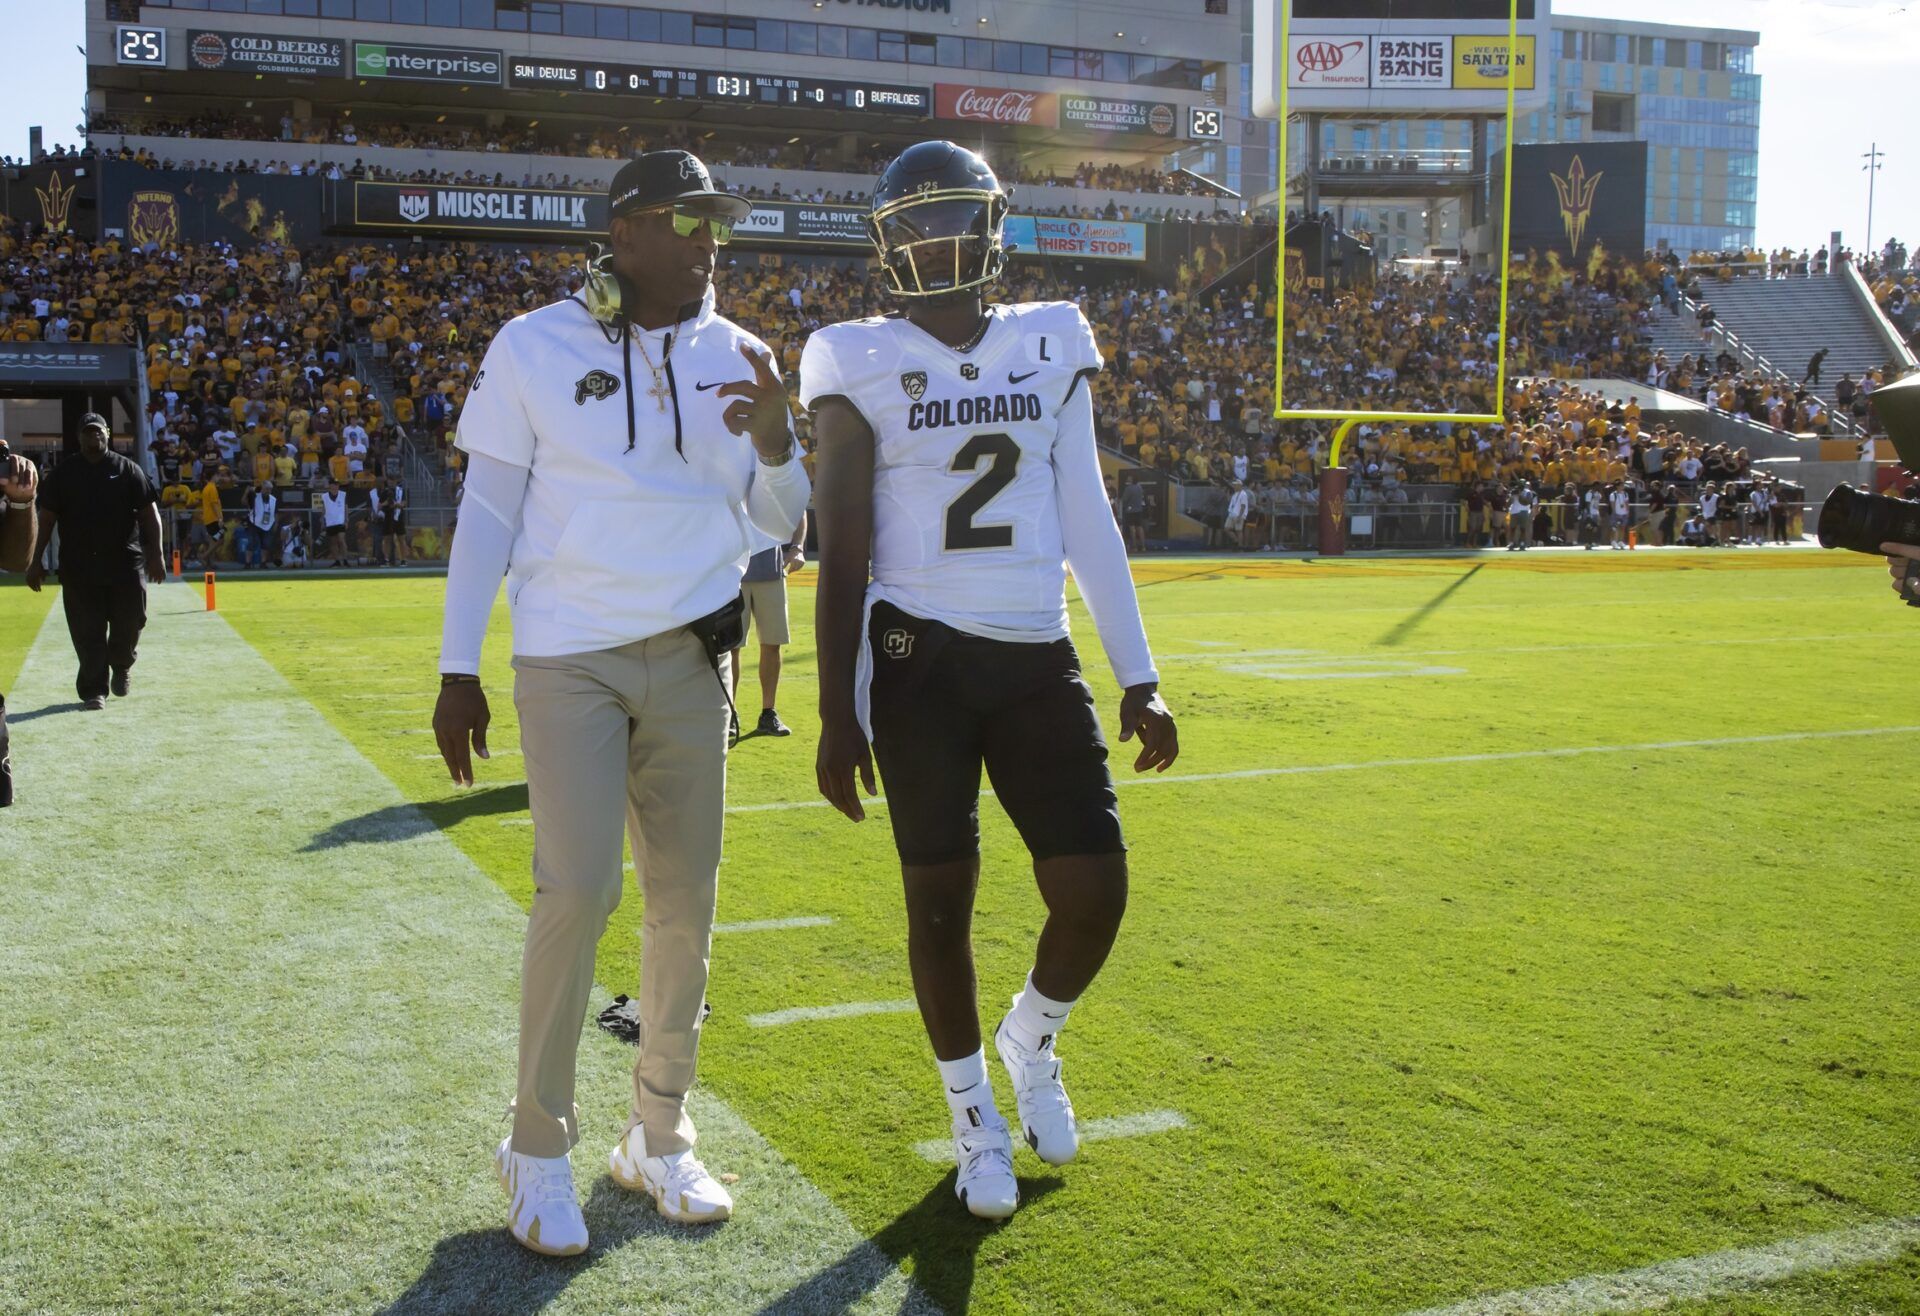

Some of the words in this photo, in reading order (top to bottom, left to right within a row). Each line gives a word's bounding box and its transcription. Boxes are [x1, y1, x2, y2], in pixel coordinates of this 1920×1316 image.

[123, 32, 159, 59] 25
[231, 37, 272, 51] COLD
[276, 40, 328, 54] BEERS
[331, 44, 341, 55] &
[1380, 40, 1443, 59] BANG
[231, 51, 340, 66] CHEESEBURGERS
[365, 52, 498, 75] enterprise
[1302, 42, 1340, 70] AAA
[1462, 54, 1493, 65] SAN
[257, 64, 317, 74] COLDBEERS.COM
[514, 65, 535, 78] SUN
[539, 67, 577, 80] DEVILS
[652, 69, 673, 79] DOWN
[677, 71, 686, 80] TO
[687, 72, 697, 81] GO
[1380, 59, 1443, 78] BANG
[595, 70, 606, 90] 0
[629, 74, 639, 89] 0
[756, 78, 772, 87] BALL
[773, 78, 783, 87] ON
[786, 80, 799, 89] QTR
[1321, 73, 1365, 83] Insurance
[717, 76, 751, 96] 0:31
[815, 88, 824, 102] 0
[855, 89, 865, 108] 0
[871, 91, 920, 106] BUFFALOES
[1066, 99, 1096, 112] COLD
[1100, 102, 1137, 115] BEERS
[1139, 105, 1146, 116] &
[1066, 110, 1146, 126] CHEESEBURGERS
[1193, 112, 1219, 135] 25
[136, 192, 172, 204] INFERNO
[437, 190, 527, 220] MUSCLE
[532, 195, 586, 223] MILK
[750, 215, 778, 226] YOU
[798, 210, 828, 222] GILA
[830, 212, 865, 224] RIVE
[1037, 223, 1066, 233] CIRCLE
[1034, 237, 1086, 250] THIRST
[1090, 240, 1133, 255] STOP!
[1039, 336, 1051, 362] L
[908, 383, 922, 395] 12
[907, 393, 1042, 431] COLORADO
[941, 432, 1023, 554] 2
